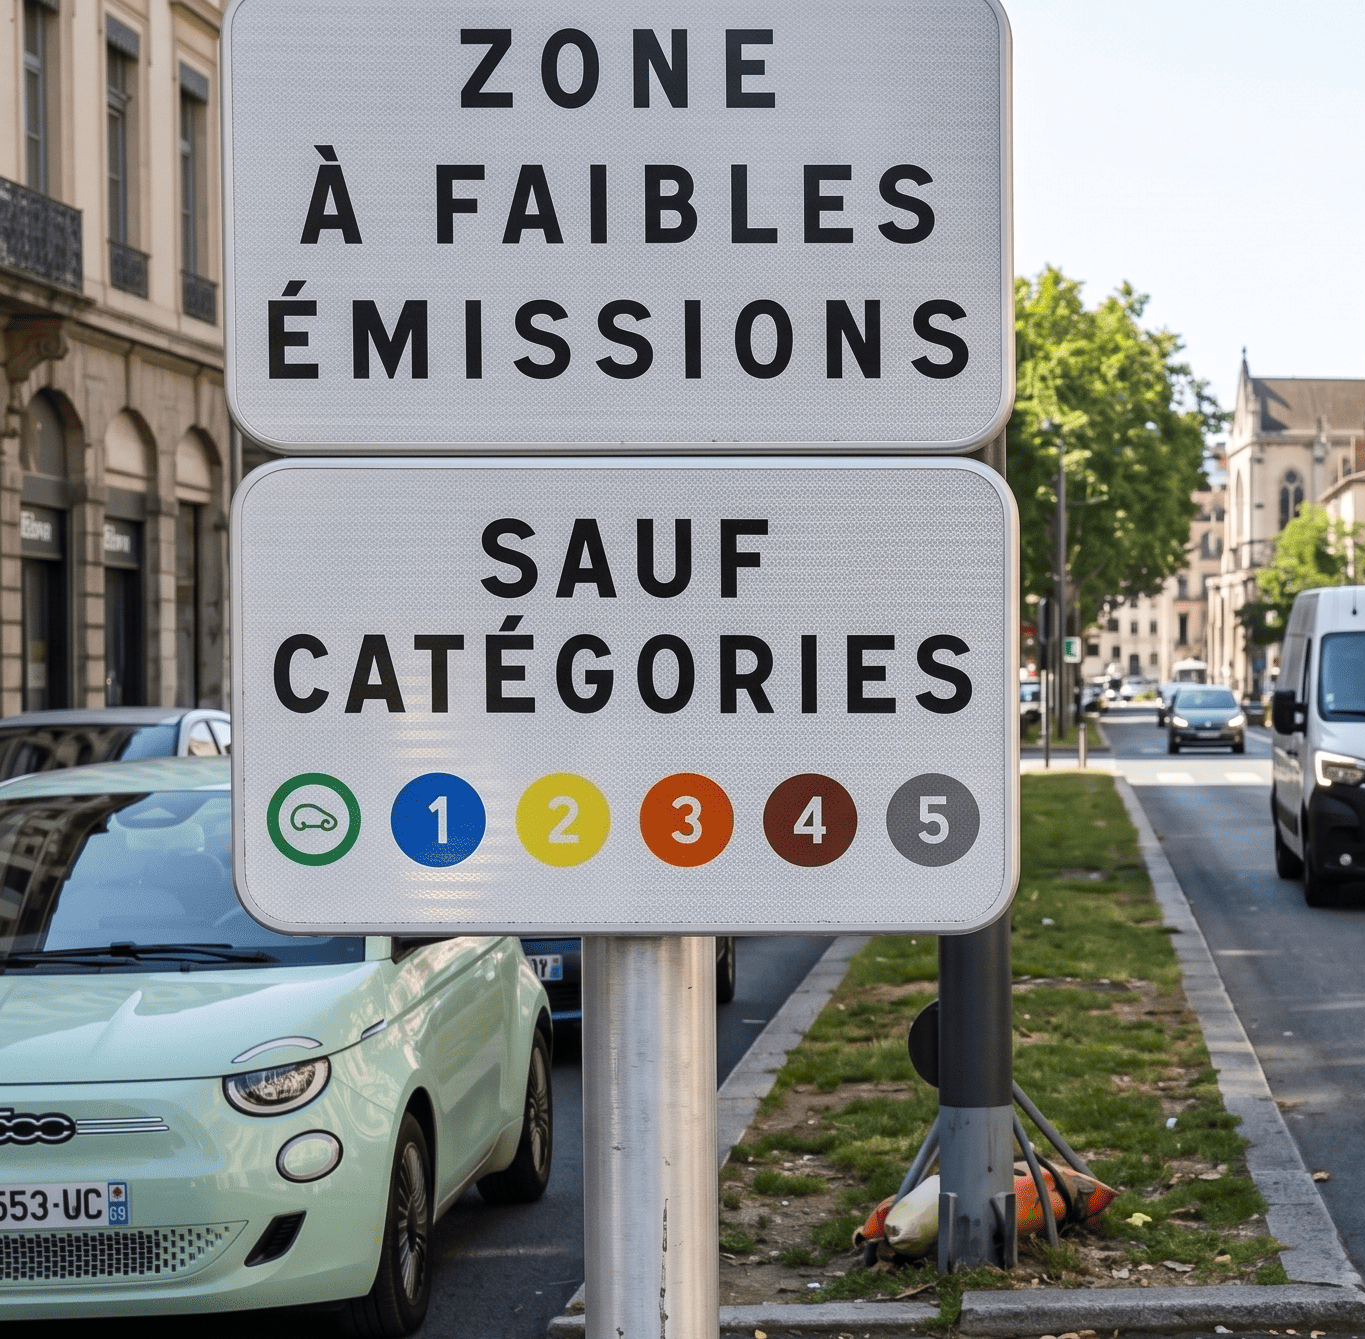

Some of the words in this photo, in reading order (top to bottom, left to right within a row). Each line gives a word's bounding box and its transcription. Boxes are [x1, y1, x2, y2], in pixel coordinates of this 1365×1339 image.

[461, 28, 775, 108] ZONE
[300, 145, 362, 244] À
[437, 164, 934, 244] FAIBLES
[268, 281, 968, 379] ÉMISSIONS
[481, 518, 768, 598] SAUF
[274, 615, 972, 714] CATÉGORIES
[428, 796, 448, 844] 1
[548, 796, 579, 845] 2
[671, 796, 703, 844] 3
[793, 796, 827, 844] 4
[917, 796, 949, 845] 5
[109, 1206, 126, 1221] 69
